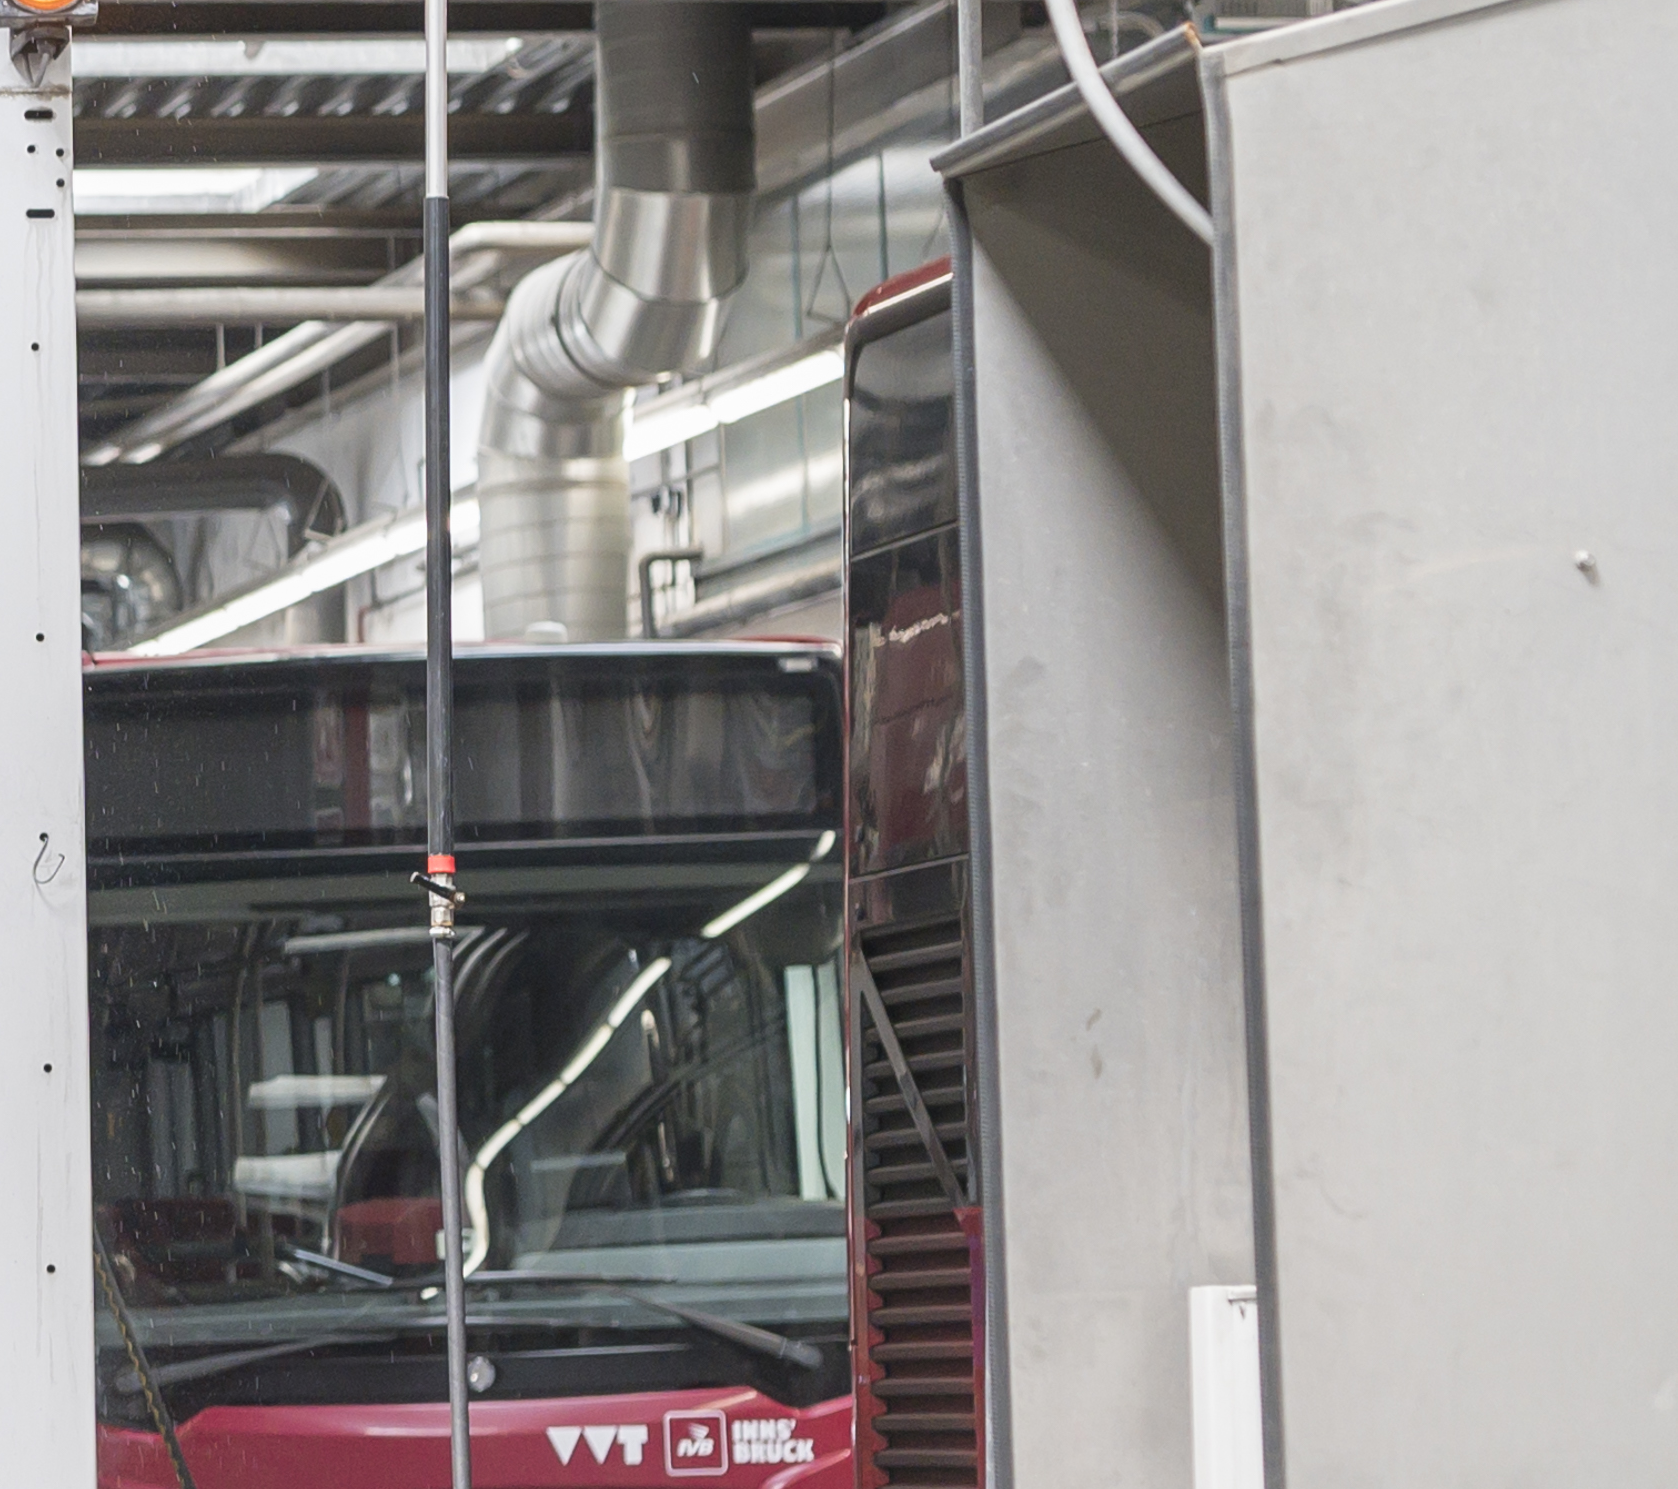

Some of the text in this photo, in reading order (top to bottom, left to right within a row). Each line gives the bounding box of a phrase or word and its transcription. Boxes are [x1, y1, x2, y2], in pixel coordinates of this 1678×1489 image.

[546, 1424, 649, 1466] VVT
[677, 1438, 715, 1458] IVB
[732, 1438, 815, 1465] BRUCK
